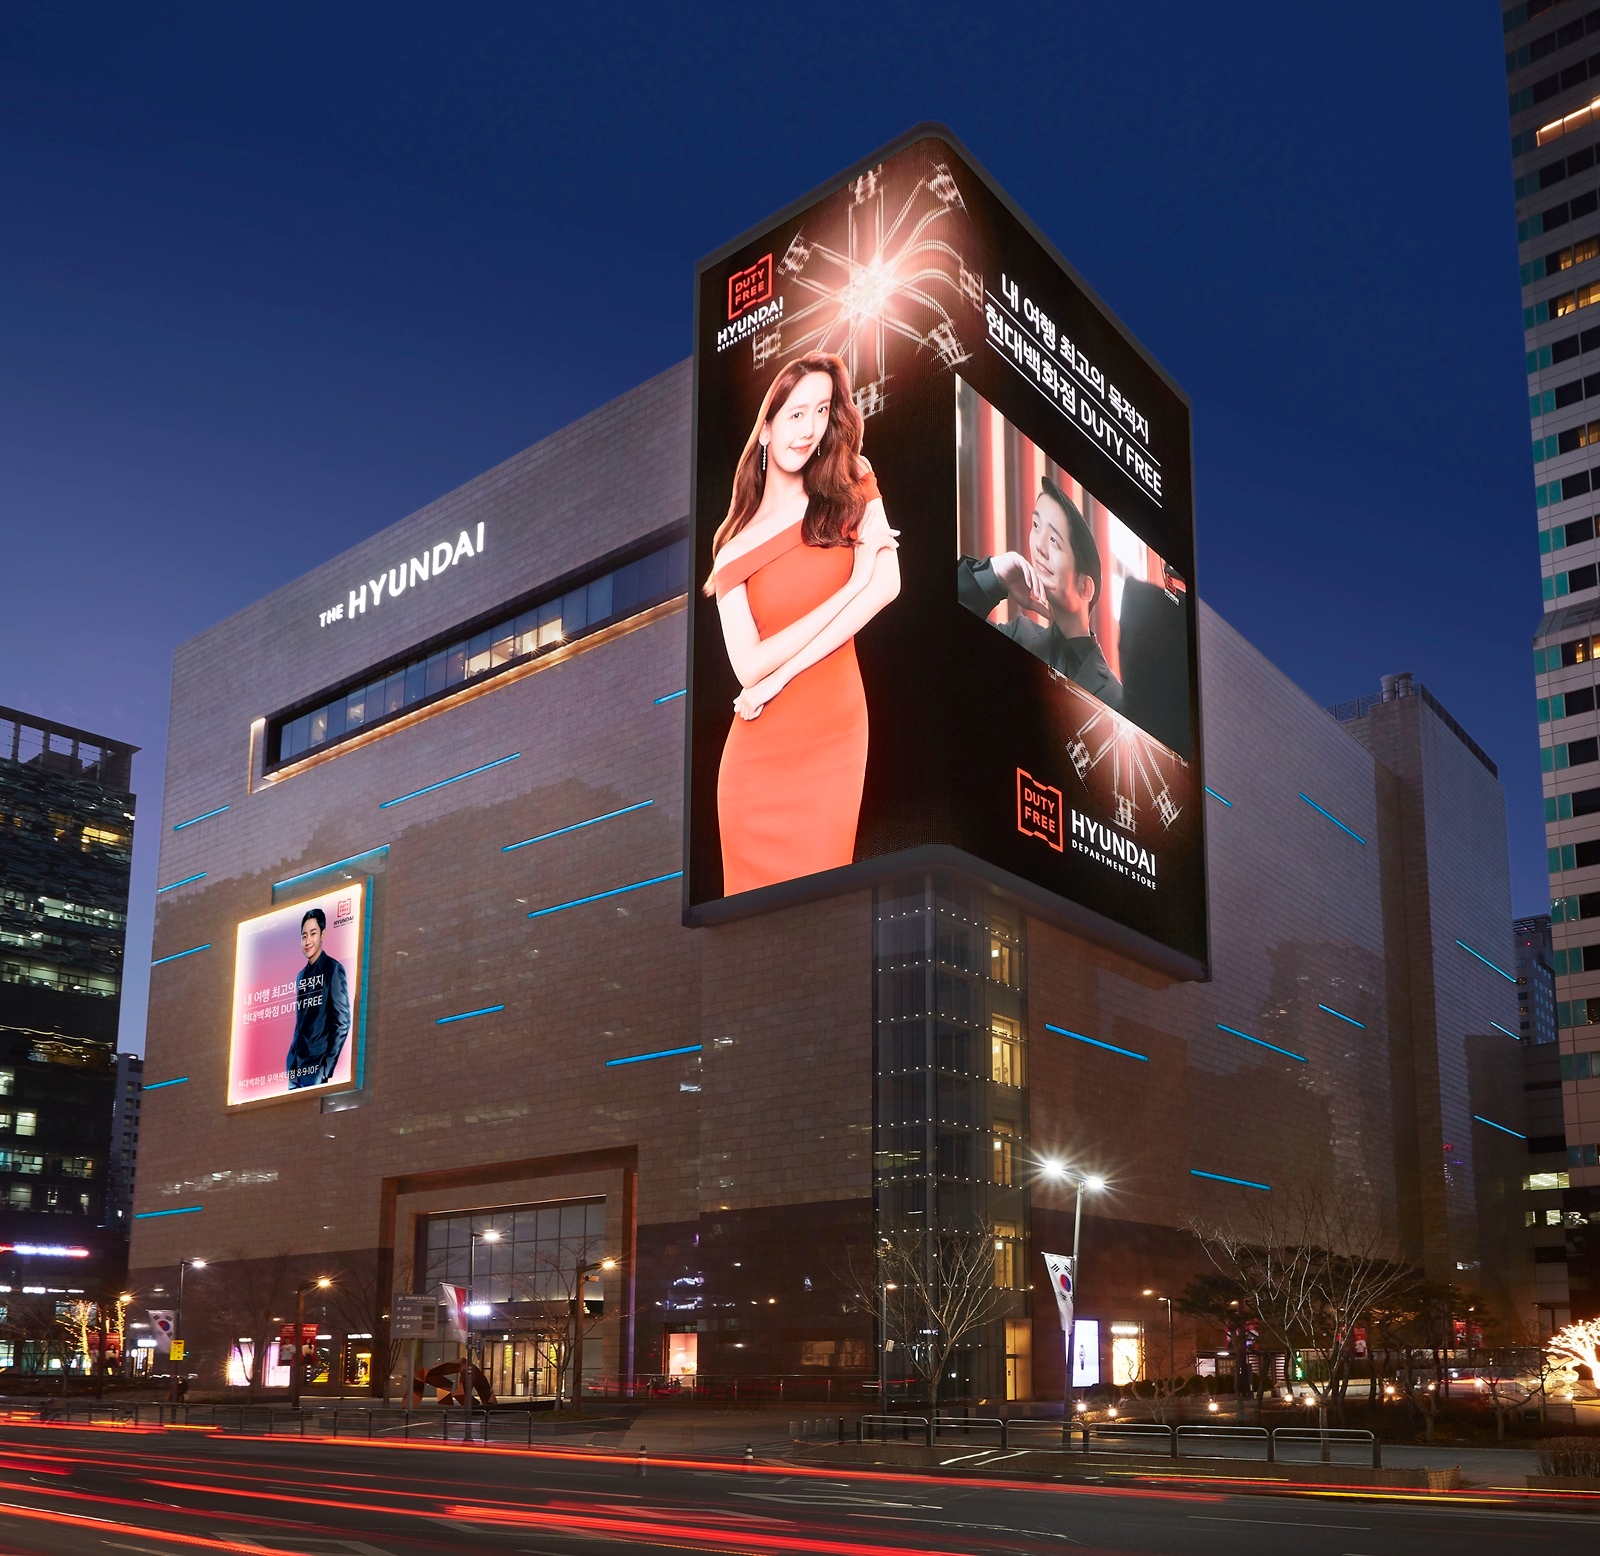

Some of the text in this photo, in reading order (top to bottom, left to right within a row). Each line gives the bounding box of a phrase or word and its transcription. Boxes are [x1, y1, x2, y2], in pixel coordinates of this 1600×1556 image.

[735, 267, 765, 293] DUTY
[735, 280, 765, 306] FREE
[717, 296, 784, 345] HYUNDAI
[717, 311, 783, 352] DEPARTMENT STORE
[1002, 273, 1149, 444] 내 여행 최고의 목적지
[985, 303, 1162, 497] 현대백화점 DUTY FREE
[319, 521, 485, 628] THE HYUNDAI
[1024, 787, 1056, 815] DUTY
[1024, 806, 1056, 834] FREE
[1071, 809, 1156, 877] HYUNDAI
[1071, 839, 1157, 891] DEPARTMENT STORE
[333, 916, 354, 926] HYUNDAI
[244, 973, 324, 1006] 내 여행 최고의 목적지
[243, 995, 323, 1025] 현대백화점 DUTY FREE
